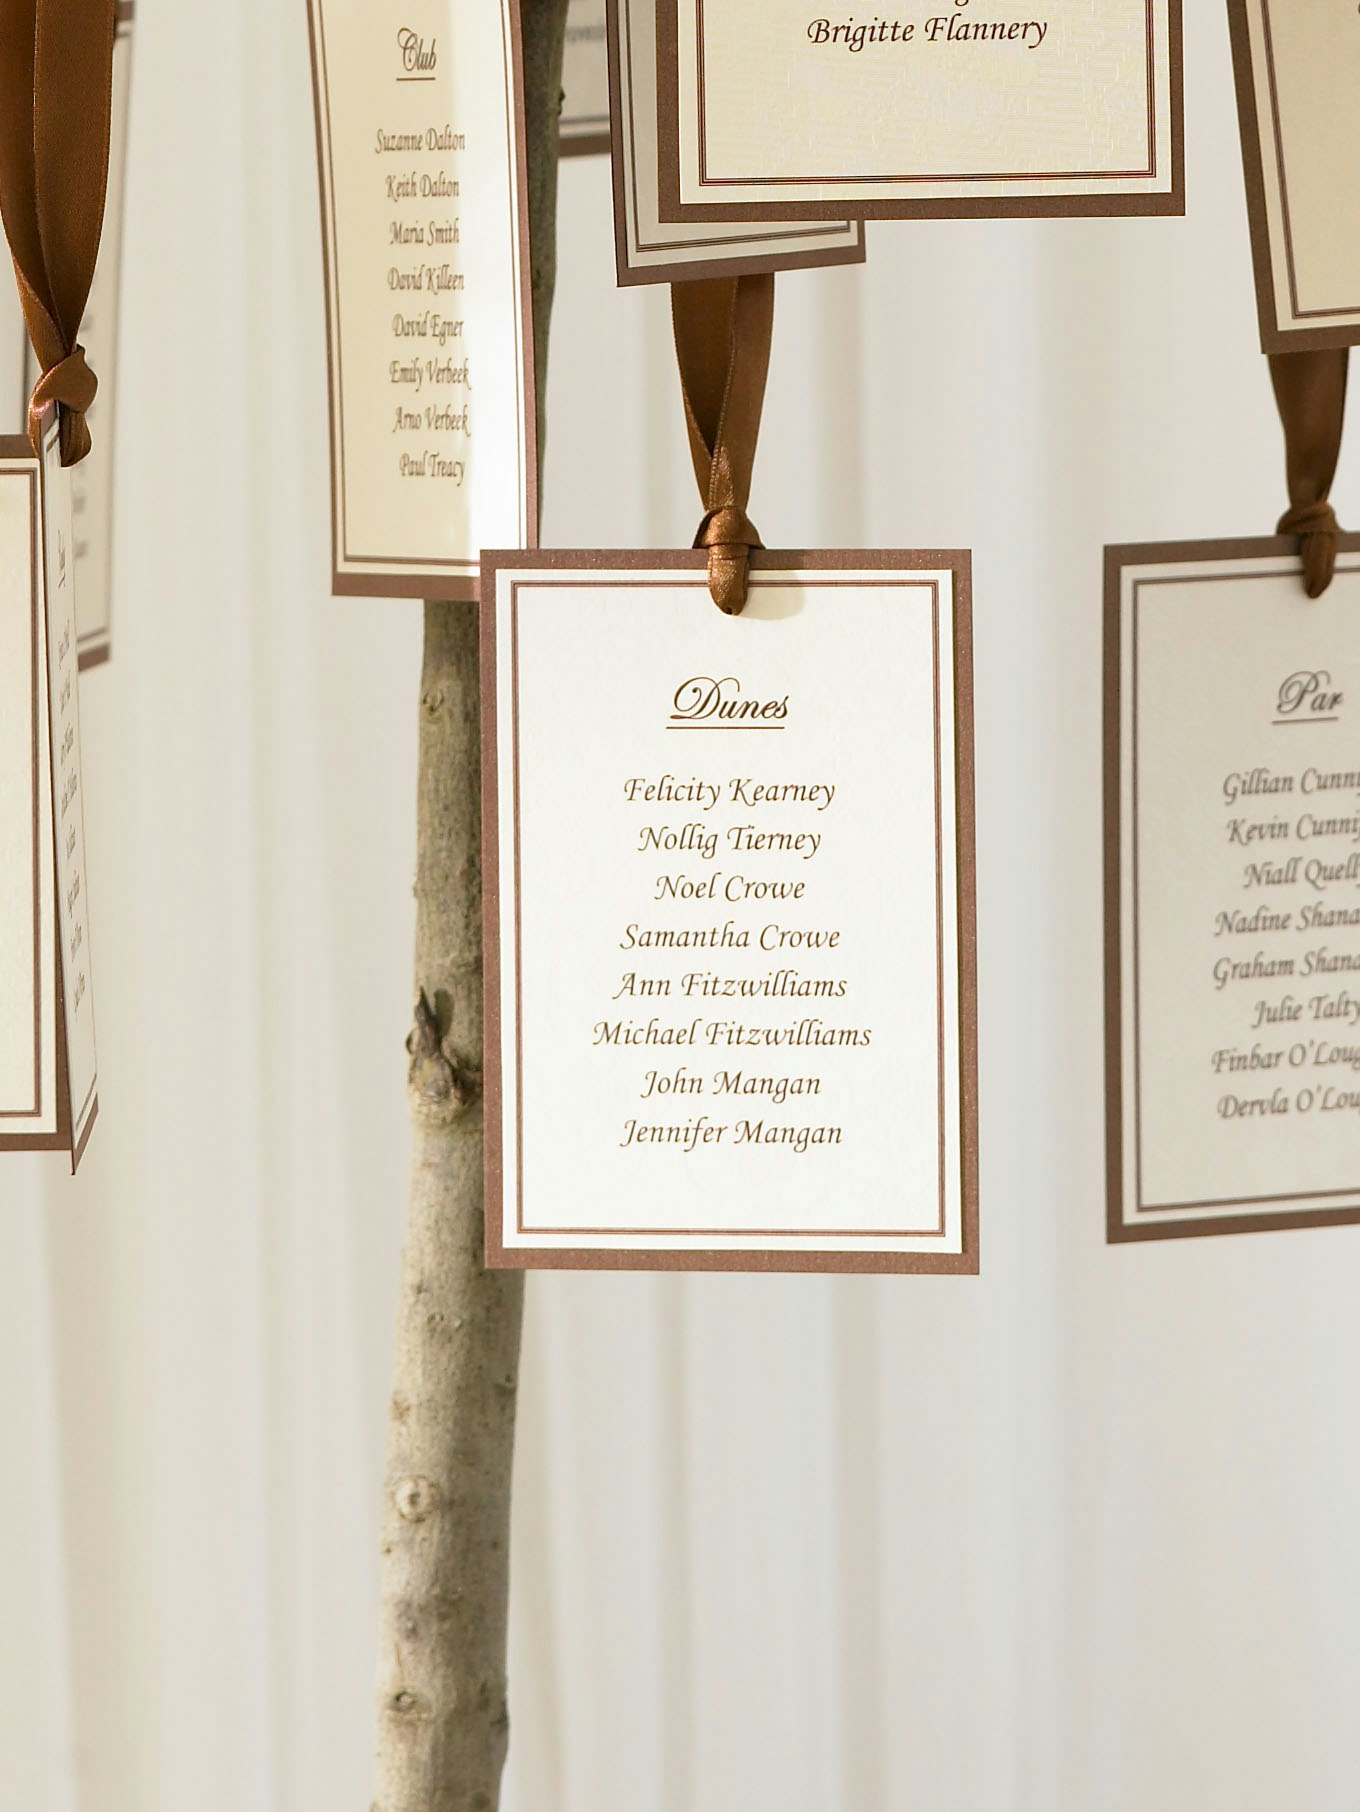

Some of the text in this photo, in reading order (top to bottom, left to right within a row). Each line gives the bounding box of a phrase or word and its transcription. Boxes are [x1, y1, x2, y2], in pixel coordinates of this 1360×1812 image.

[396, 26, 437, 72] Club
[807, 12, 1048, 53] Brigitte Flannery
[374, 123, 466, 155] Suzanne Dalton
[386, 170, 460, 203] Keith Dalton
[389, 217, 460, 247] Maria Smith
[388, 263, 426, 291] David
[393, 310, 431, 338] David
[389, 356, 472, 393] Emily Verbeek
[392, 403, 472, 438] Arno Verbeek
[399, 449, 429, 477] Paul
[669, 676, 790, 720] Dunes
[1276, 670, 1344, 715] Par
[623, 774, 836, 811] Felicity Kearney
[1222, 767, 1294, 807] Gillian
[637, 822, 822, 860] Nollig Tierney
[1226, 818, 1289, 847] Kevin
[654, 871, 806, 902] Noel Crowe
[1242, 856, 1303, 889] Niall
[619, 920, 840, 951] Samantha Crowe
[1214, 904, 1292, 937] Nadine
[611, 969, 848, 1000] Ann Fitzwilliams
[1212, 950, 1295, 991] Graham
[1250, 994, 1304, 1029] Julie
[592, 1016, 872, 1046] Michael Fitzwilliams
[1211, 1042, 1285, 1074] Finbar
[640, 1066, 820, 1104] John Mangan
[1217, 1087, 1289, 1120] Dervla
[619, 1116, 842, 1153] Jennifer Mangan
